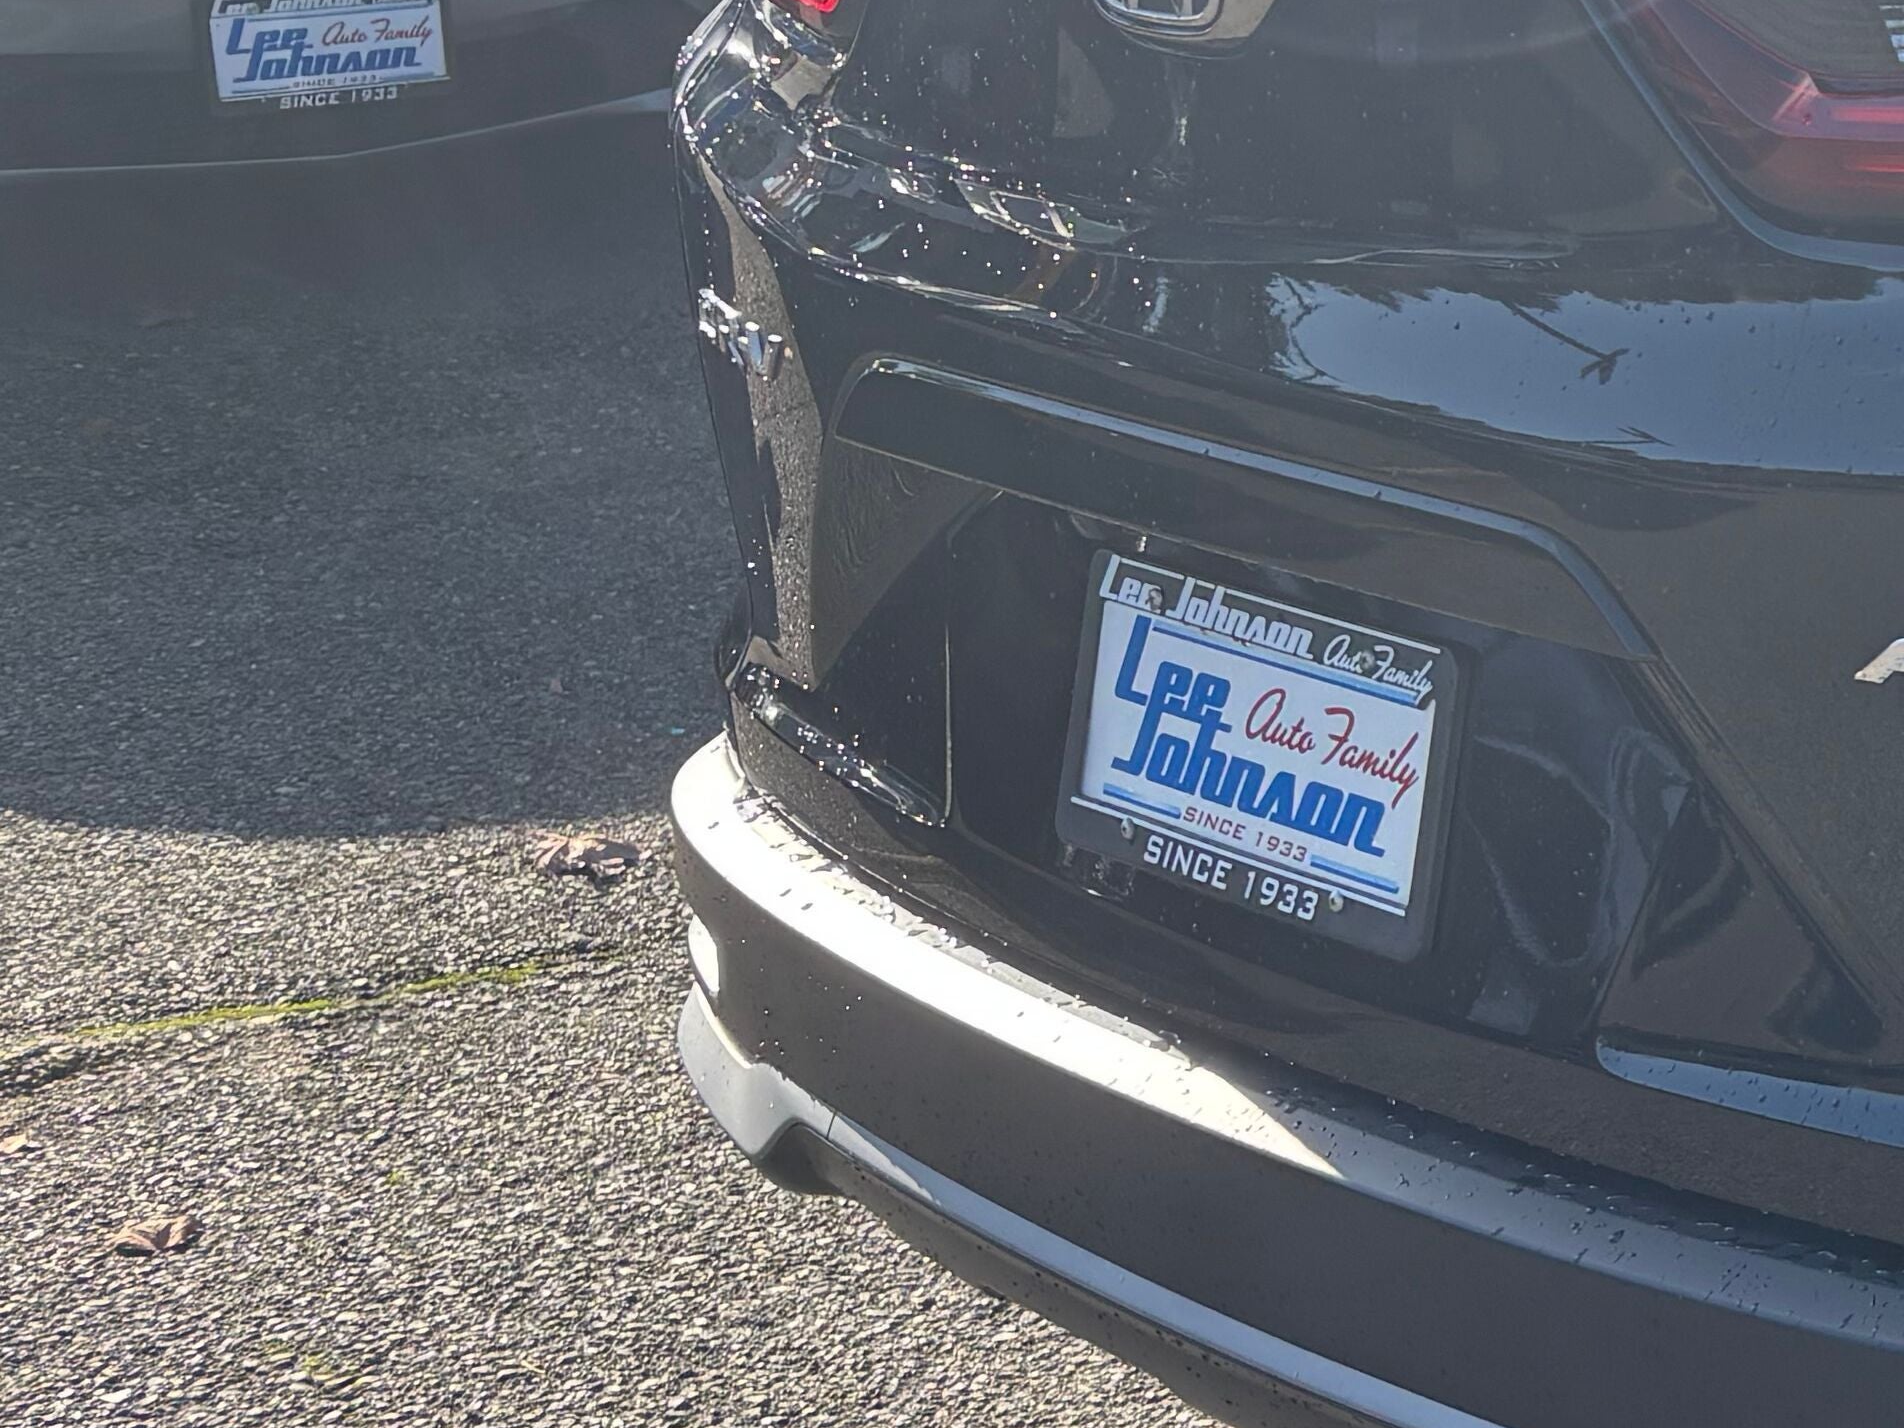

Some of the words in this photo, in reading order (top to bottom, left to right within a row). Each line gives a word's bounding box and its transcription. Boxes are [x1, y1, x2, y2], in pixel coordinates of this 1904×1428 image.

[226, 18, 309, 55] Lee
[322, 22, 368, 46] Auto
[370, 15, 432, 47] Family
[233, 41, 421, 83] Johnson
[280, 92, 341, 109] SINCE
[352, 86, 398, 103] 1933
[1165, 576, 1314, 660] Johnson
[1372, 645, 1433, 706] Family
[1115, 615, 1232, 719] Lee
[1245, 688, 1316, 754] Auto
[1322, 707, 1419, 809] Family
[1111, 709, 1386, 858] Johnson
[1182, 806, 1246, 841] SINCE
[1254, 830, 1309, 863] 1933
[1143, 834, 1233, 891] SINCE
[1242, 871, 1320, 922] 1933
